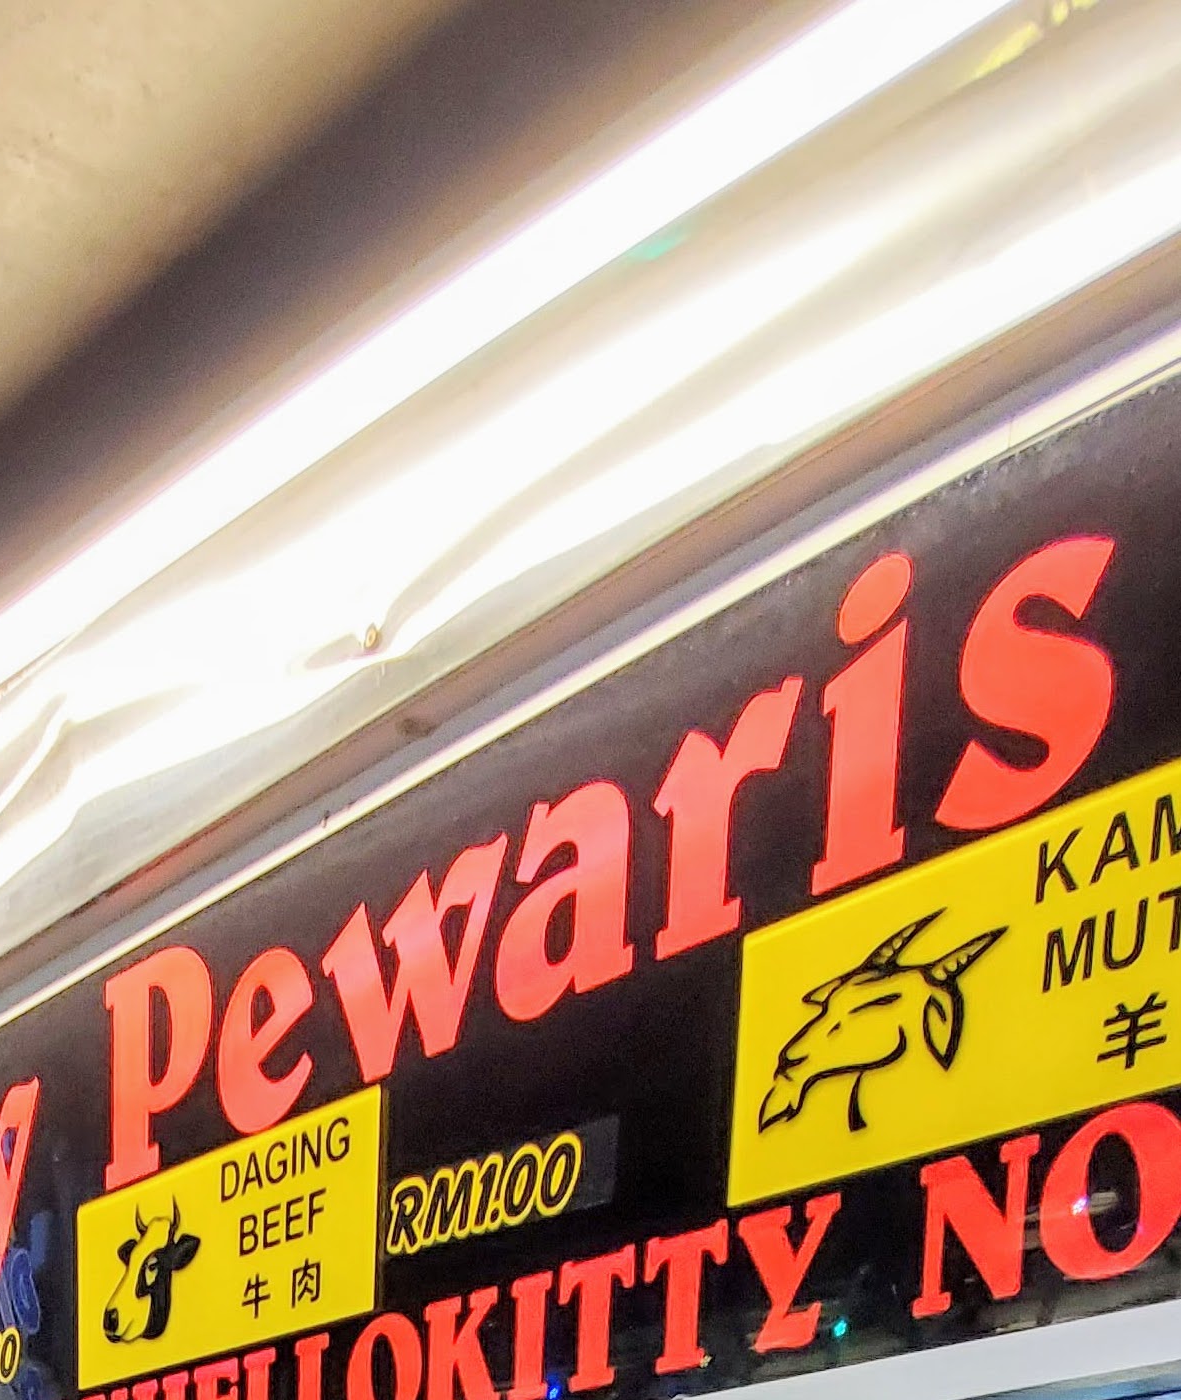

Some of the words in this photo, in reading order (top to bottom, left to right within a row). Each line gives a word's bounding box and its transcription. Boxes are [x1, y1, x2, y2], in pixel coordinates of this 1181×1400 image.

[103, 535, 1115, 1192] Pewaris
[1096, 991, 1168, 1070] 羊
[221, 1117, 350, 1203] DAGING
[387, 1132, 582, 1253] RM1.00
[239, 1187, 327, 1257] BEEF
[241, 1257, 321, 1319] 牛肉
